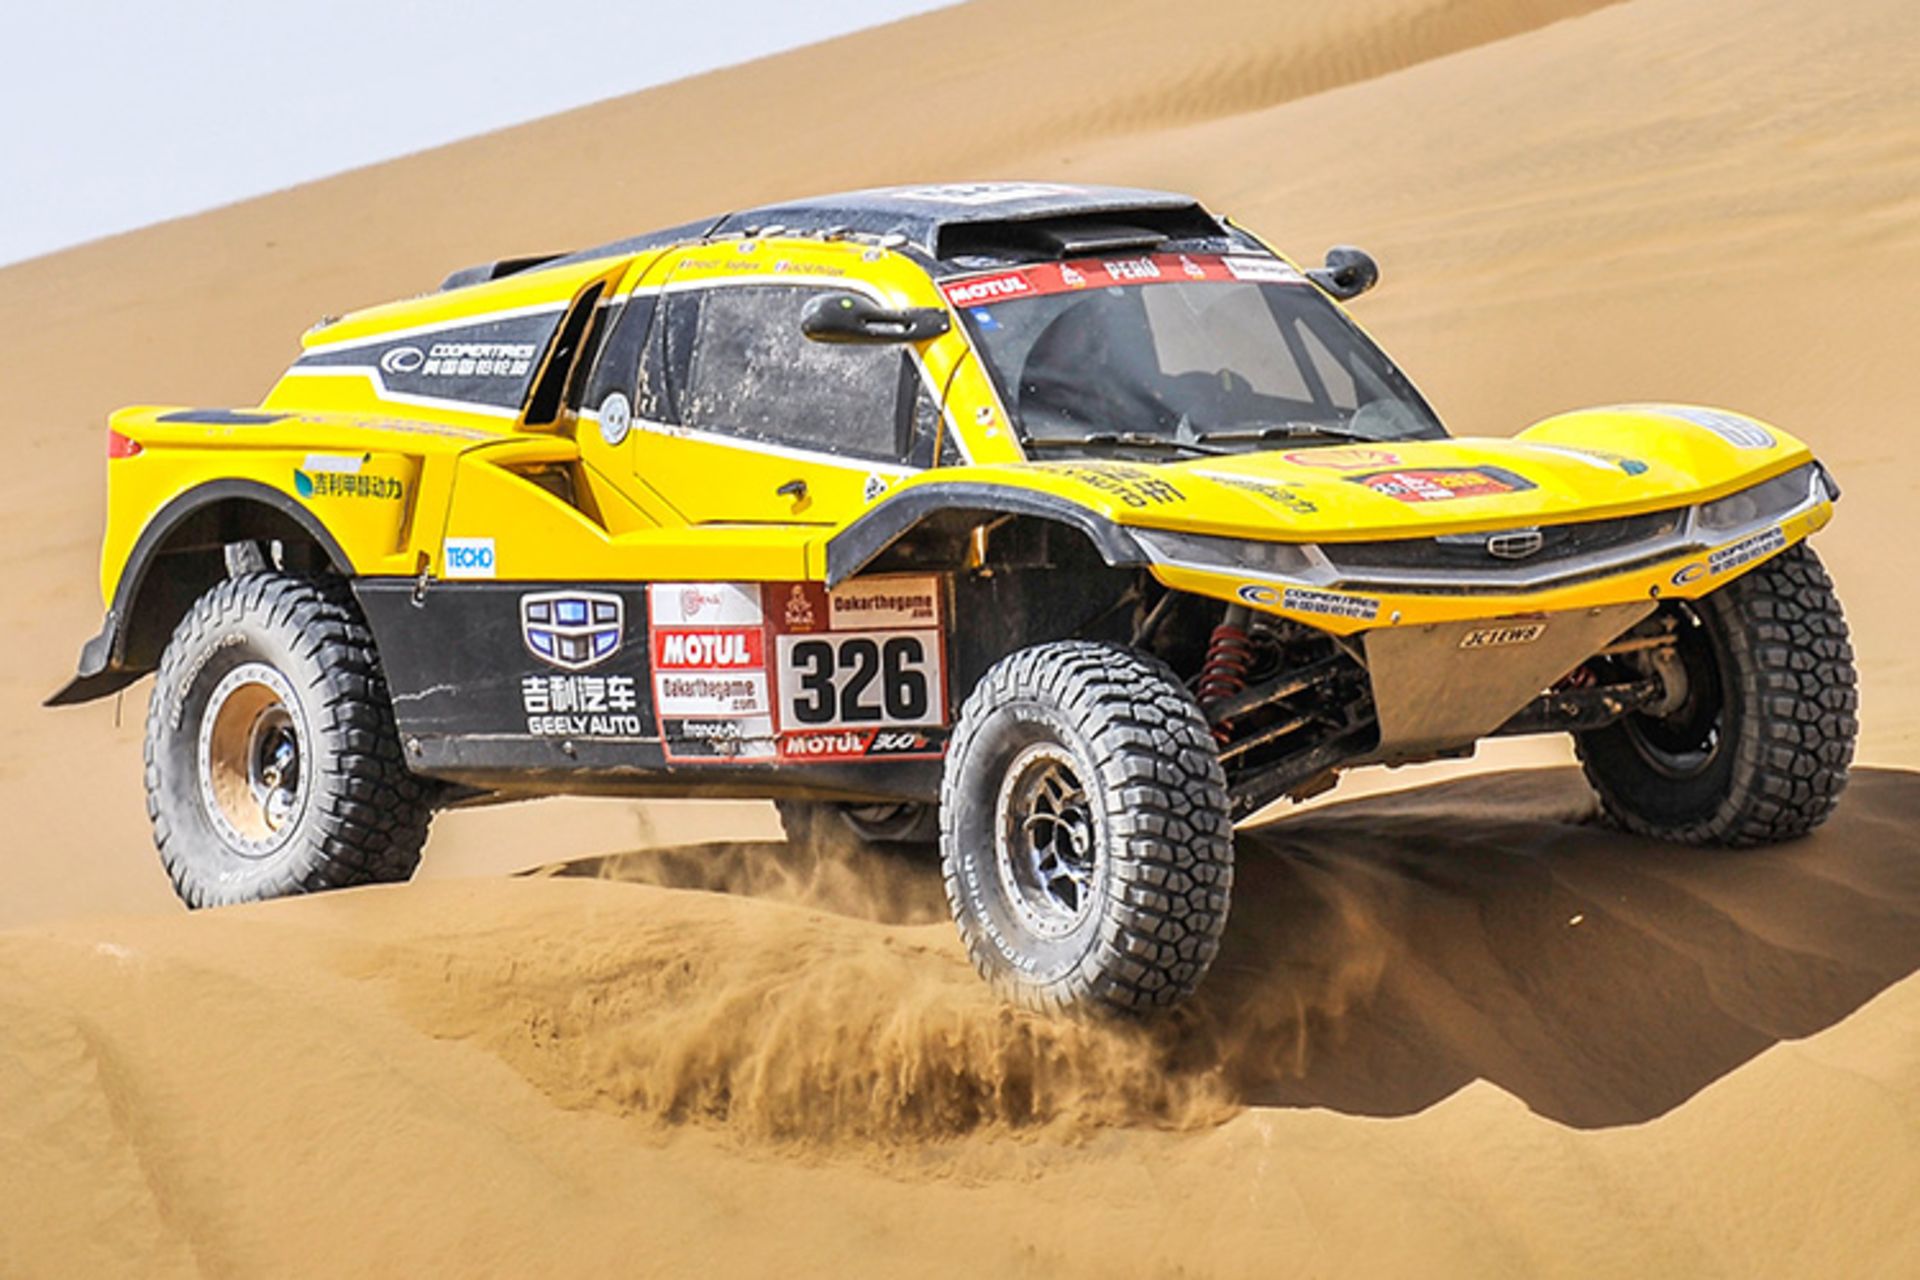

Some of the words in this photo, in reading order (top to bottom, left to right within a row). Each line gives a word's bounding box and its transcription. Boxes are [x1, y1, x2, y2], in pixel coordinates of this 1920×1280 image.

[949, 278, 1028, 304] MOTUL
[447, 546, 494, 569] TECHO
[663, 633, 751, 665] MOTUL
[521, 675, 637, 713] 吉利汽车
[791, 636, 928, 723] 326
[785, 730, 866, 755] MOTUL
